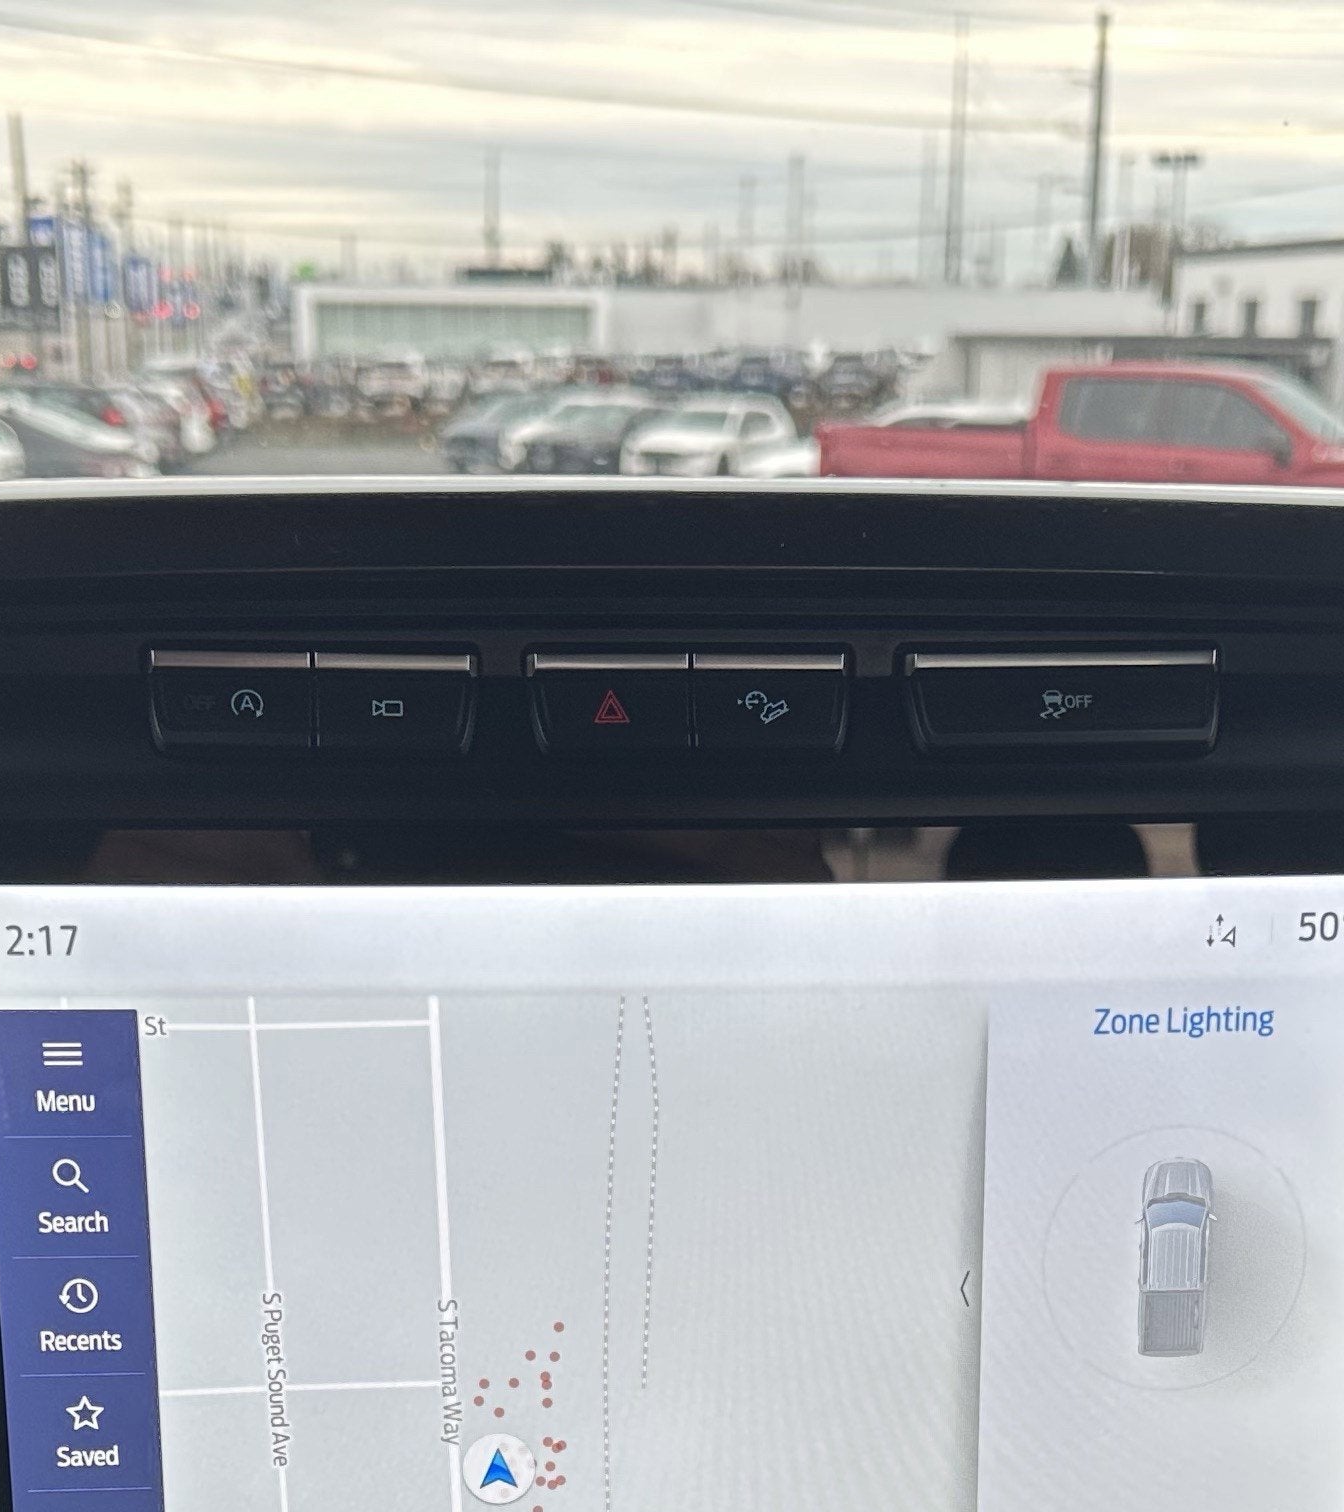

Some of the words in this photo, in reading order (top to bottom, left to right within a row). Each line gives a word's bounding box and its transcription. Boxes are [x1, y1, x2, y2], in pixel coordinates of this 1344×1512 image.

[1065, 695, 1091, 708] OFF
[6, 925, 77, 956] 2:17
[144, 1015, 167, 1037] St
[1094, 1009, 1159, 1034] Zone
[1168, 1006, 1274, 1038] Lighting
[37, 1090, 95, 1111] Menu
[39, 1211, 108, 1233] Search
[262, 1293, 282, 1305] S
[437, 1299, 458, 1313] S
[40, 1331, 122, 1351] Recents
[261, 1309, 284, 1365] Puget
[438, 1316, 459, 1398] Tacoma
[267, 1369, 290, 1428] Sound
[440, 1401, 464, 1446] Way
[57, 1445, 119, 1467] Saved
[271, 1431, 291, 1468] Ave
